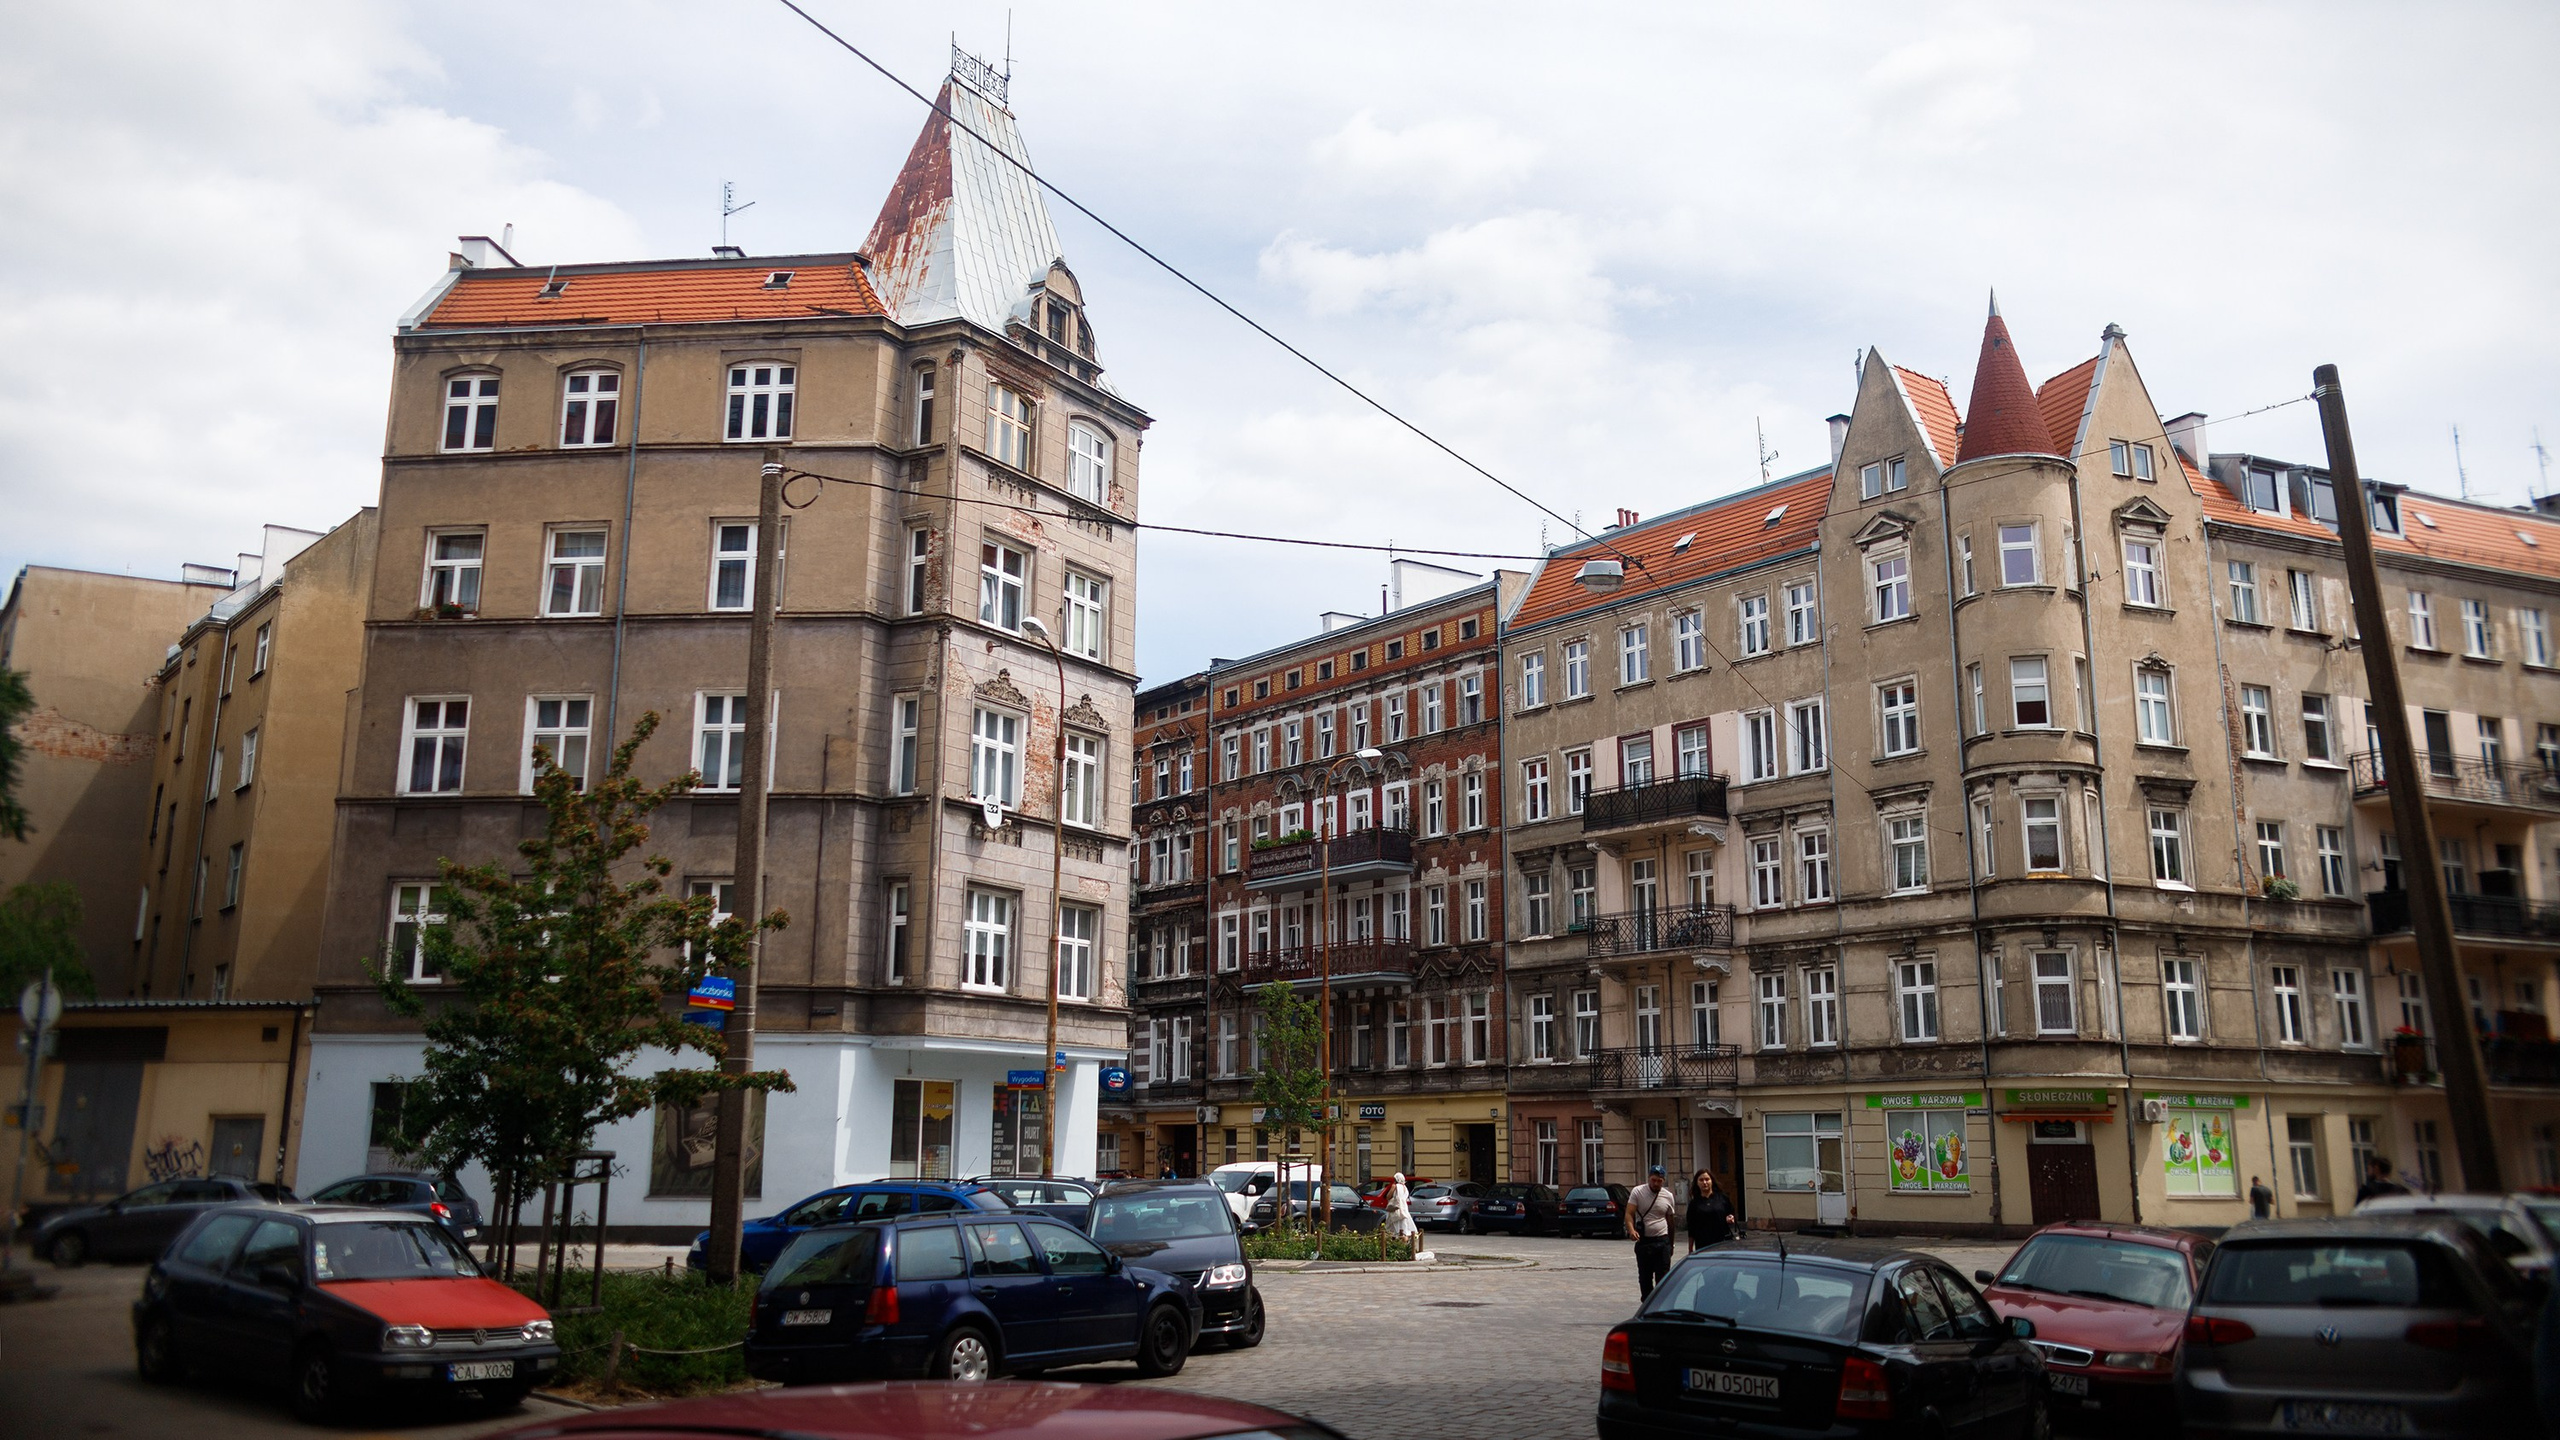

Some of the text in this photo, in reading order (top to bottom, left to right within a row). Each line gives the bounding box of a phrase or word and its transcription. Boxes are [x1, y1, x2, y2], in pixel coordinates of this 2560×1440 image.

[1011, 1075, 1040, 1085] Wygodna
[1882, 1095, 1965, 1105] OWOCE WARZYWA
[2019, 1092, 2094, 1102] SŁONECZNIK
[2194, 1096, 2235, 1106] WARZYWA
[1360, 1106, 1385, 1115] FOTO
[1024, 1126, 1040, 1139] HURT
[1023, 1144, 1041, 1158] DETAL
[1900, 1181, 1967, 1190] OWOCE WARZYWA
[456, 1366, 479, 1379] CAL
[1692, 1370, 1776, 1398] DW 050HK
